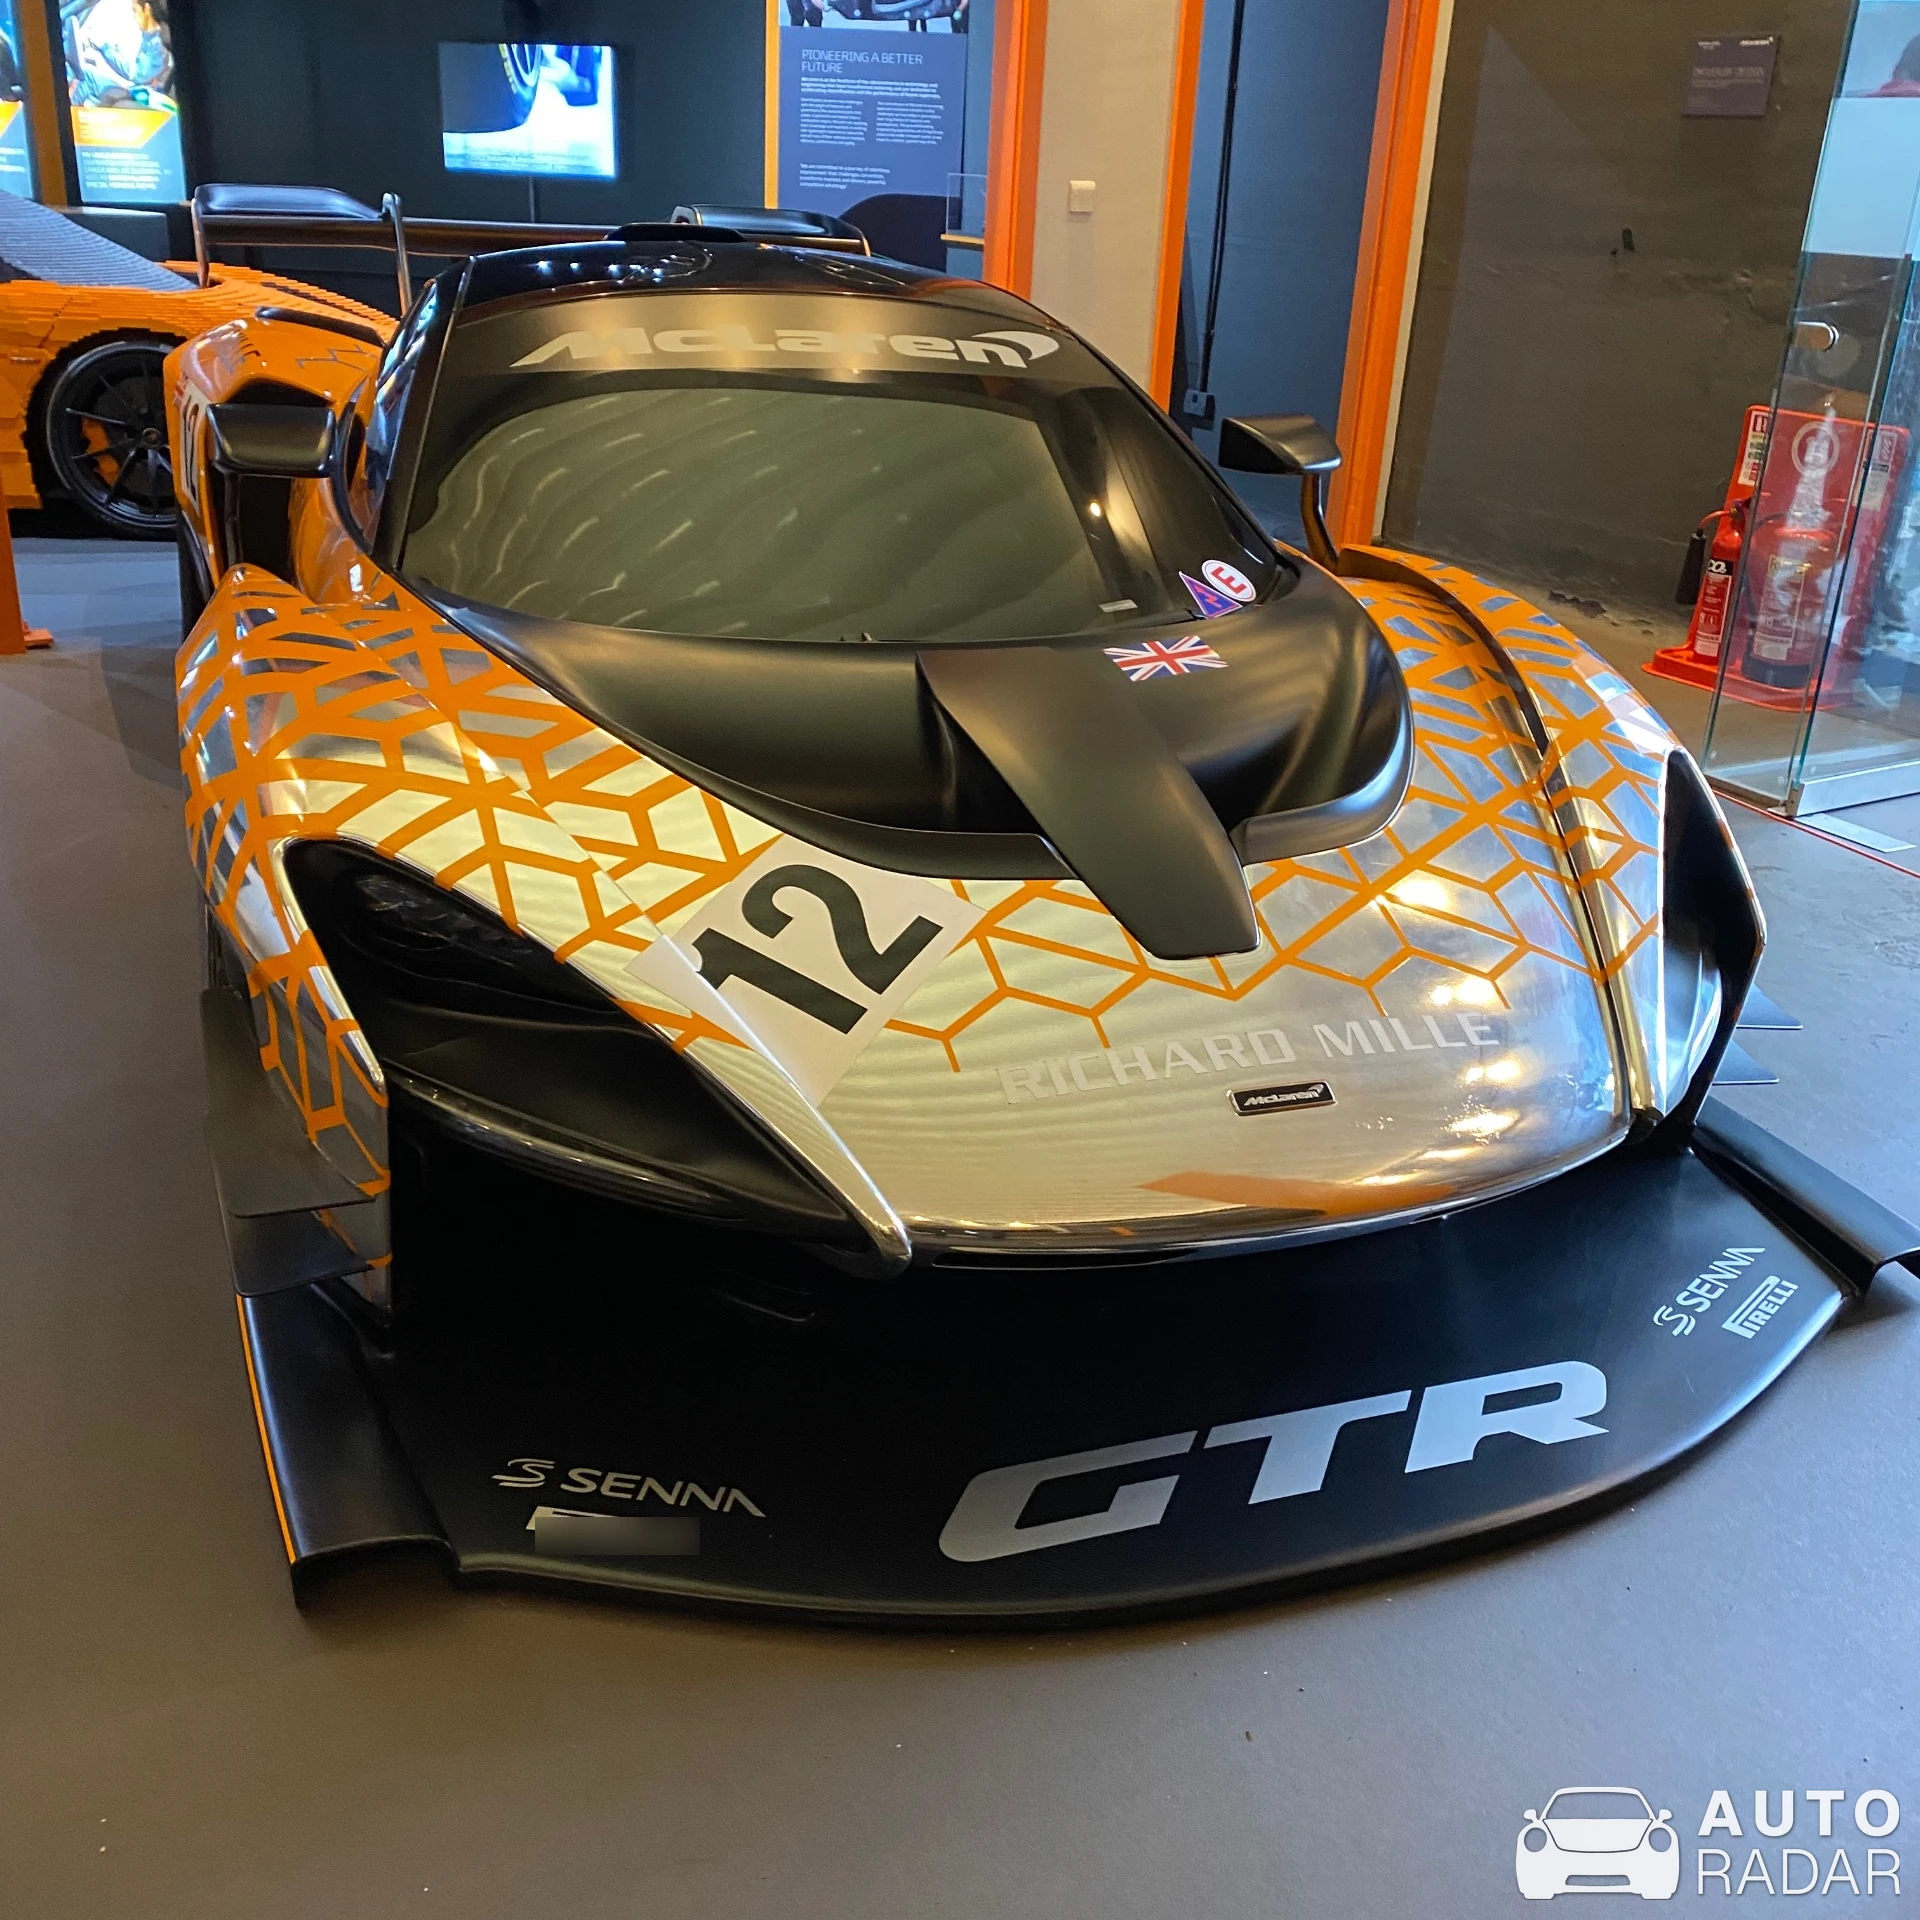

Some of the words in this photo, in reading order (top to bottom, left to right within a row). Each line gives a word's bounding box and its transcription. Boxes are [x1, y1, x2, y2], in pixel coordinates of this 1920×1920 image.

[801, 49, 869, 63] PIONEERING
[871, 52, 880, 63] A
[881, 52, 923, 65] BETTER
[801, 61, 844, 73] FUTURE
[509, 327, 1060, 368] McLaren
[1210, 566, 1248, 595] E
[691, 864, 944, 1035] 12
[998, 1028, 1297, 1104] RICHARD
[1312, 1011, 1500, 1060] MILLE
[1244, 1084, 1324, 1106] McLaren
[1721, 1275, 1799, 1340] PIRELLI
[938, 1360, 1610, 1562] GTR
